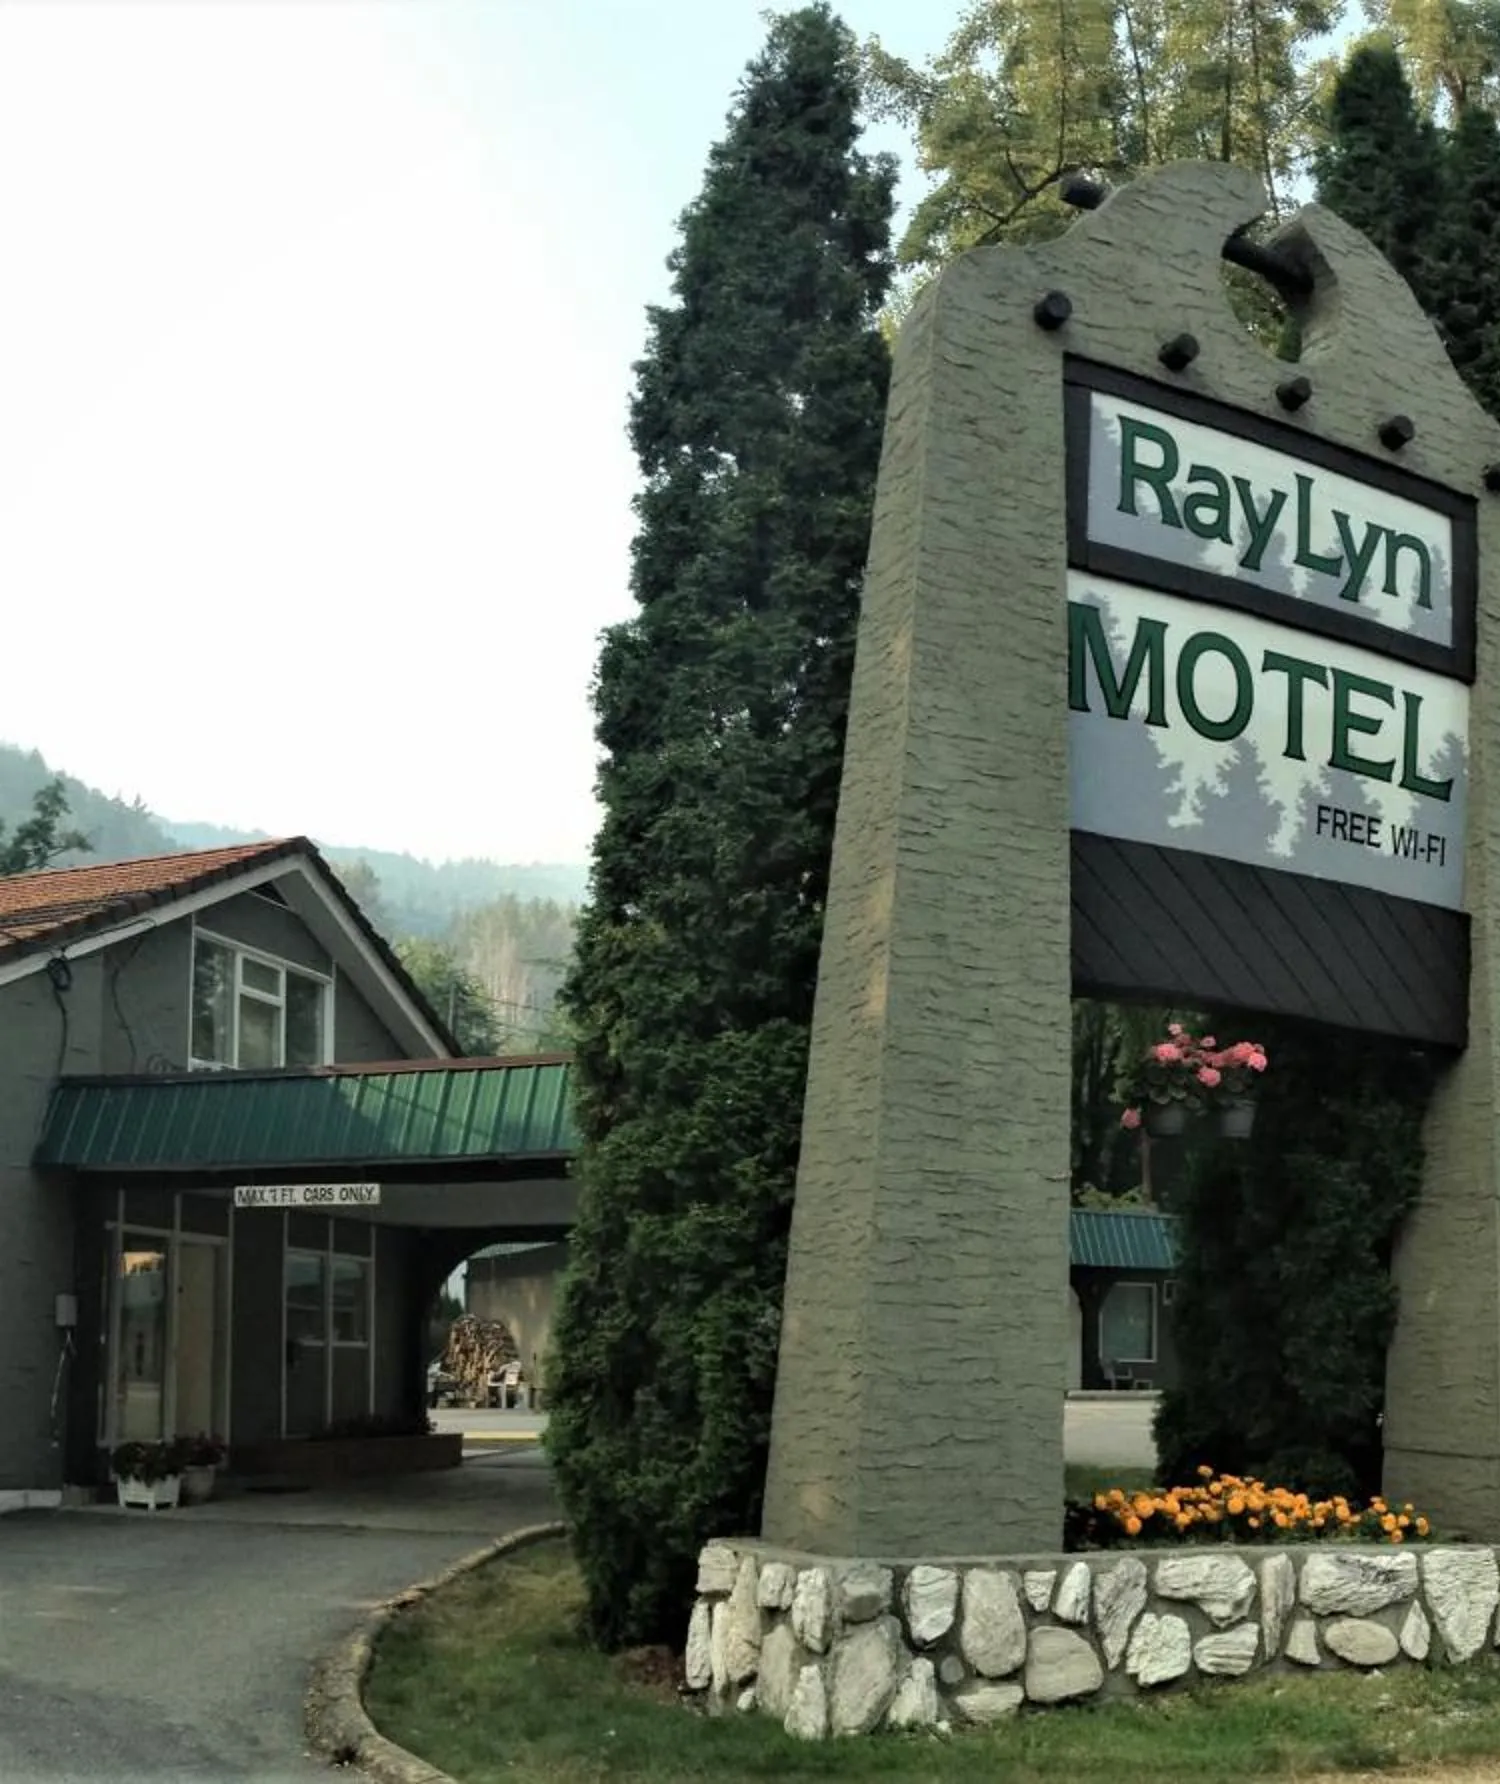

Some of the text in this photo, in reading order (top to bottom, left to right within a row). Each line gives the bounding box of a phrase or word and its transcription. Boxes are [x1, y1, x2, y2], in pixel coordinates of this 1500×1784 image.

[1116, 414, 1433, 610] RayLyn
[1067, 600, 1454, 802] MOTEL
[1316, 805, 1446, 866] FREE WI-FI
[303, 1187, 335, 1202] CARS
